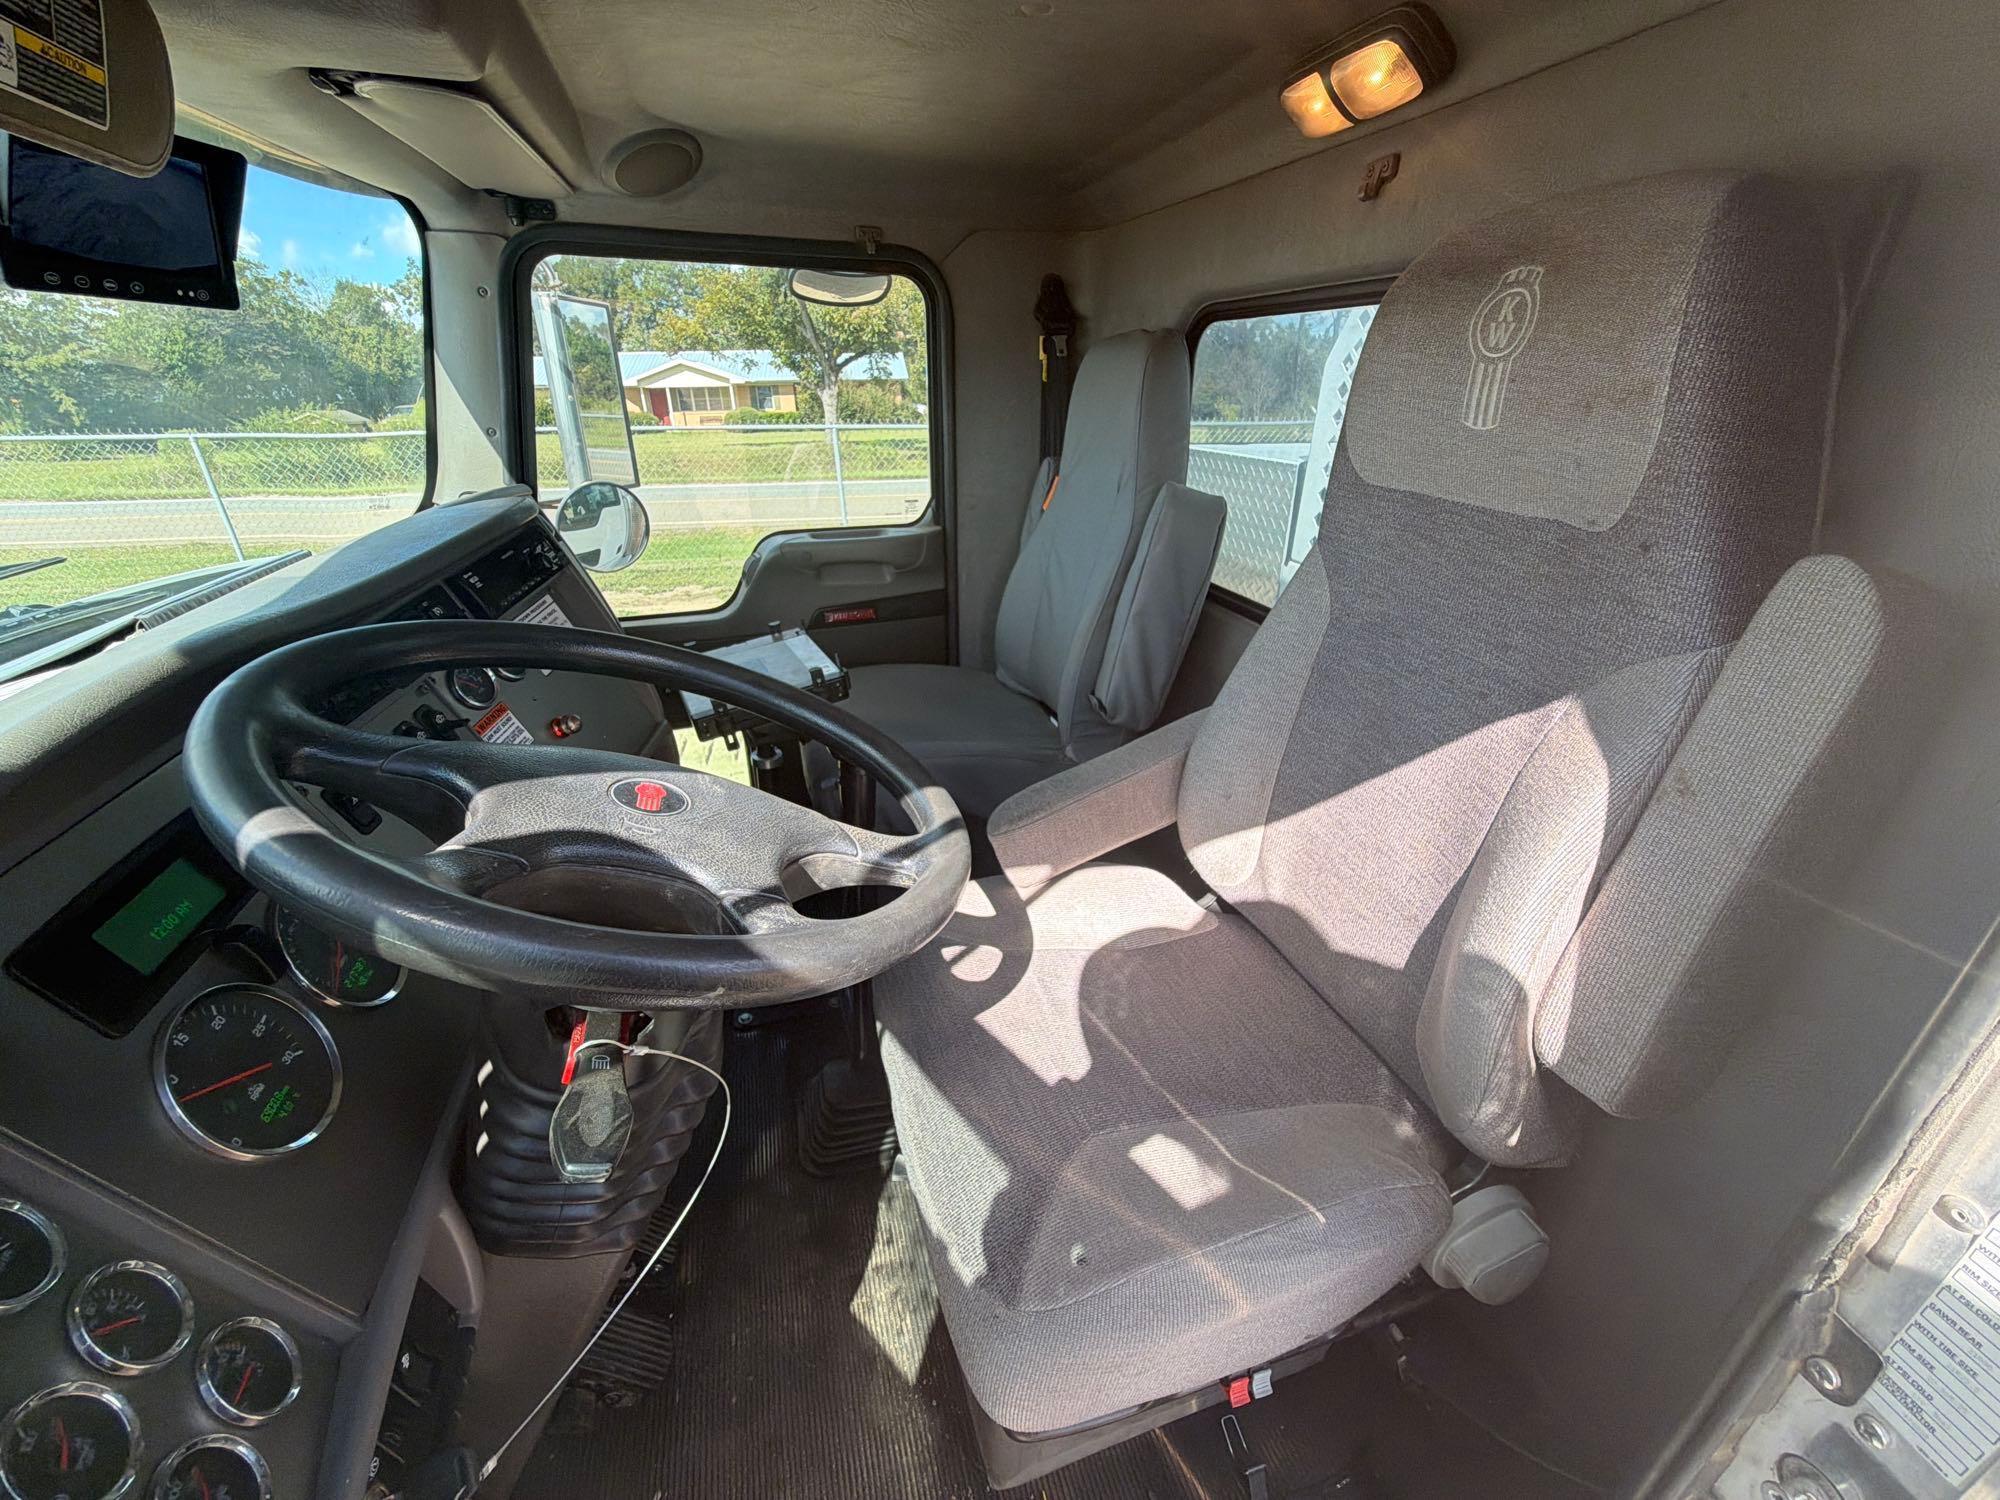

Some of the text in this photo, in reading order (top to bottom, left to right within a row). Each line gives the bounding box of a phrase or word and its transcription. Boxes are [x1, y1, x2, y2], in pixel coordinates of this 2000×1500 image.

[478, 704, 508, 731] WARNING
[210, 1014, 226, 1031] 20
[251, 1022, 267, 1038] 25
[281, 1050, 296, 1065] 30
[1912, 1319, 1938, 1343] WITH
[1936, 1340, 1958, 1360] TIRE
[1955, 1357, 1979, 1379] SIZE
[1956, 1326, 1984, 1350] REAR
[1915, 1352, 1937, 1372] SIZE
[1894, 1365, 1912, 1381] PSI
[1909, 1378, 1935, 1403] COLD
